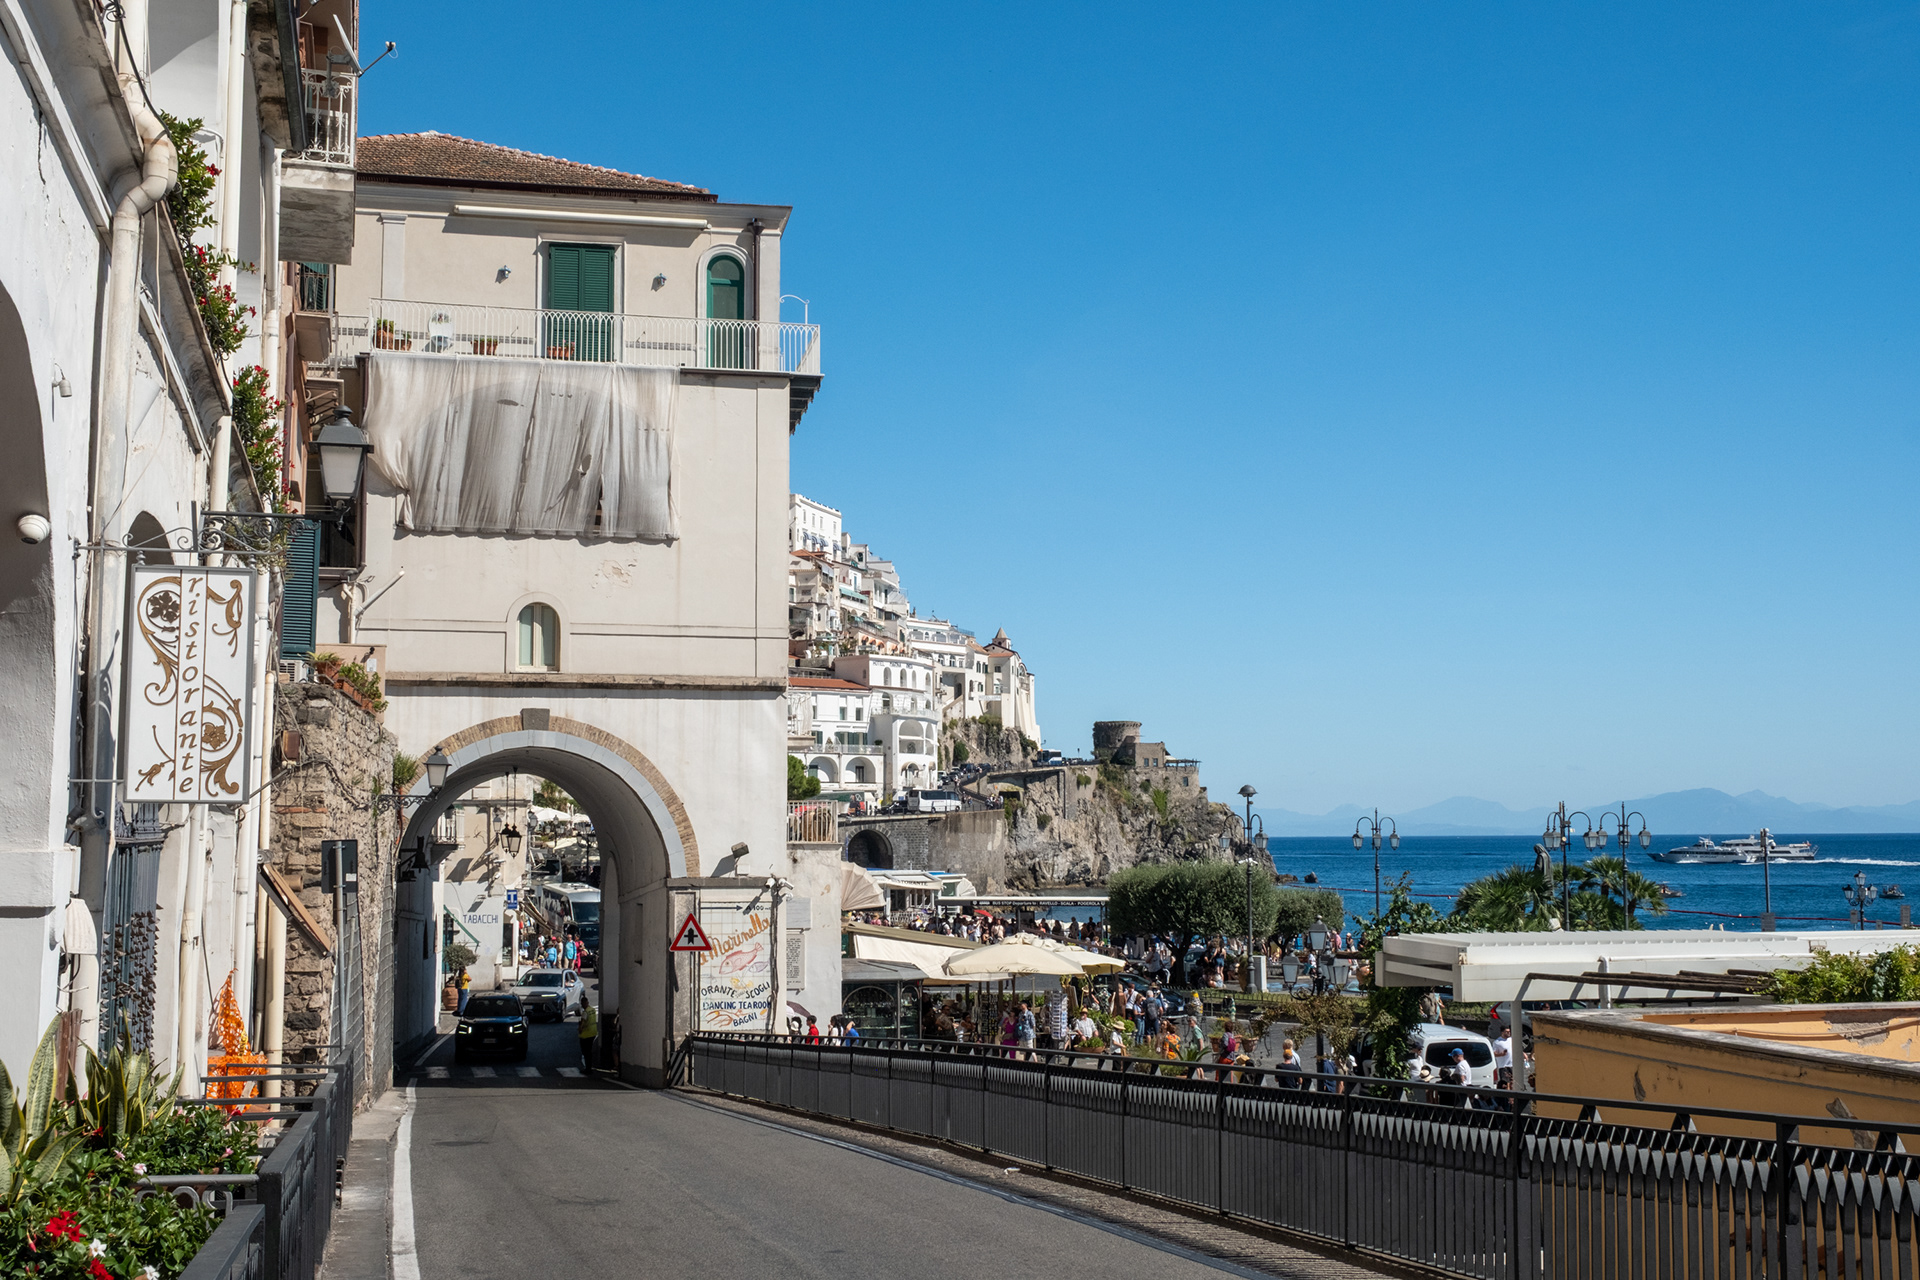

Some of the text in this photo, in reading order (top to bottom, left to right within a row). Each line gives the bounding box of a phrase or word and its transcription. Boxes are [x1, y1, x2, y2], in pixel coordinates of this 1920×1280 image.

[179, 575, 203, 793] ristorante
[463, 915, 498, 924] TABACCHI
[707, 912, 770, 960] Marinella
[745, 981, 771, 999] SCOGLI
[703, 1001, 737, 1010] DANCING
[732, 1012, 758, 1027] BAGNI
